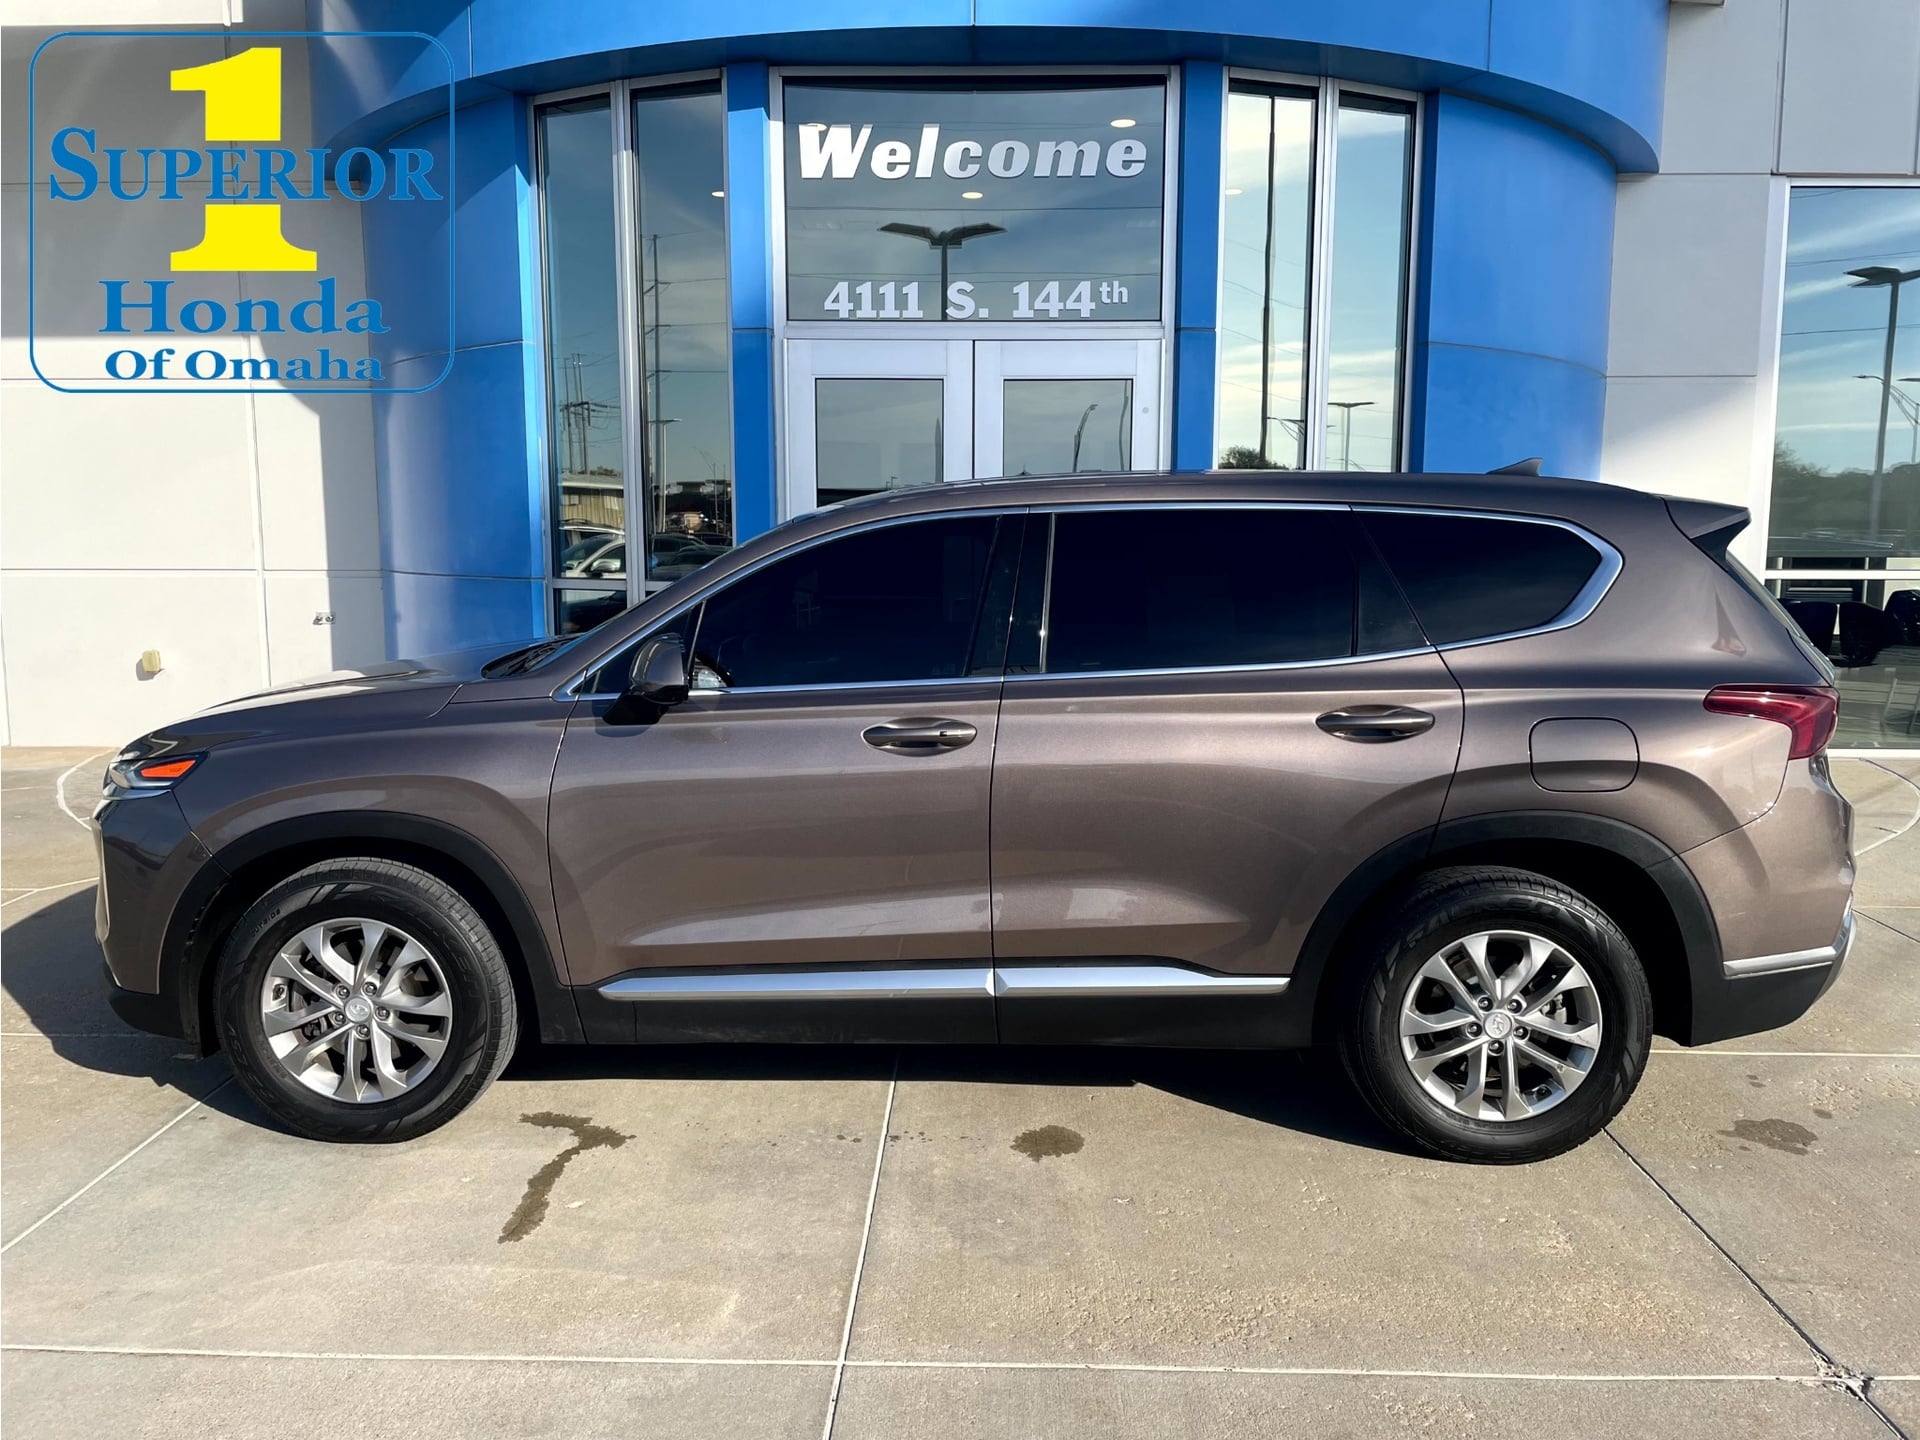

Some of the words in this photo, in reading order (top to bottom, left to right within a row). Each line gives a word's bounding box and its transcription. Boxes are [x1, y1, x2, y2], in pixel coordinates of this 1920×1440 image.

[798, 123, 1147, 180] Welcome
[824, 281, 924, 319] 4111
[945, 280, 989, 319] S.
[1012, 280, 1129, 318] 144th
